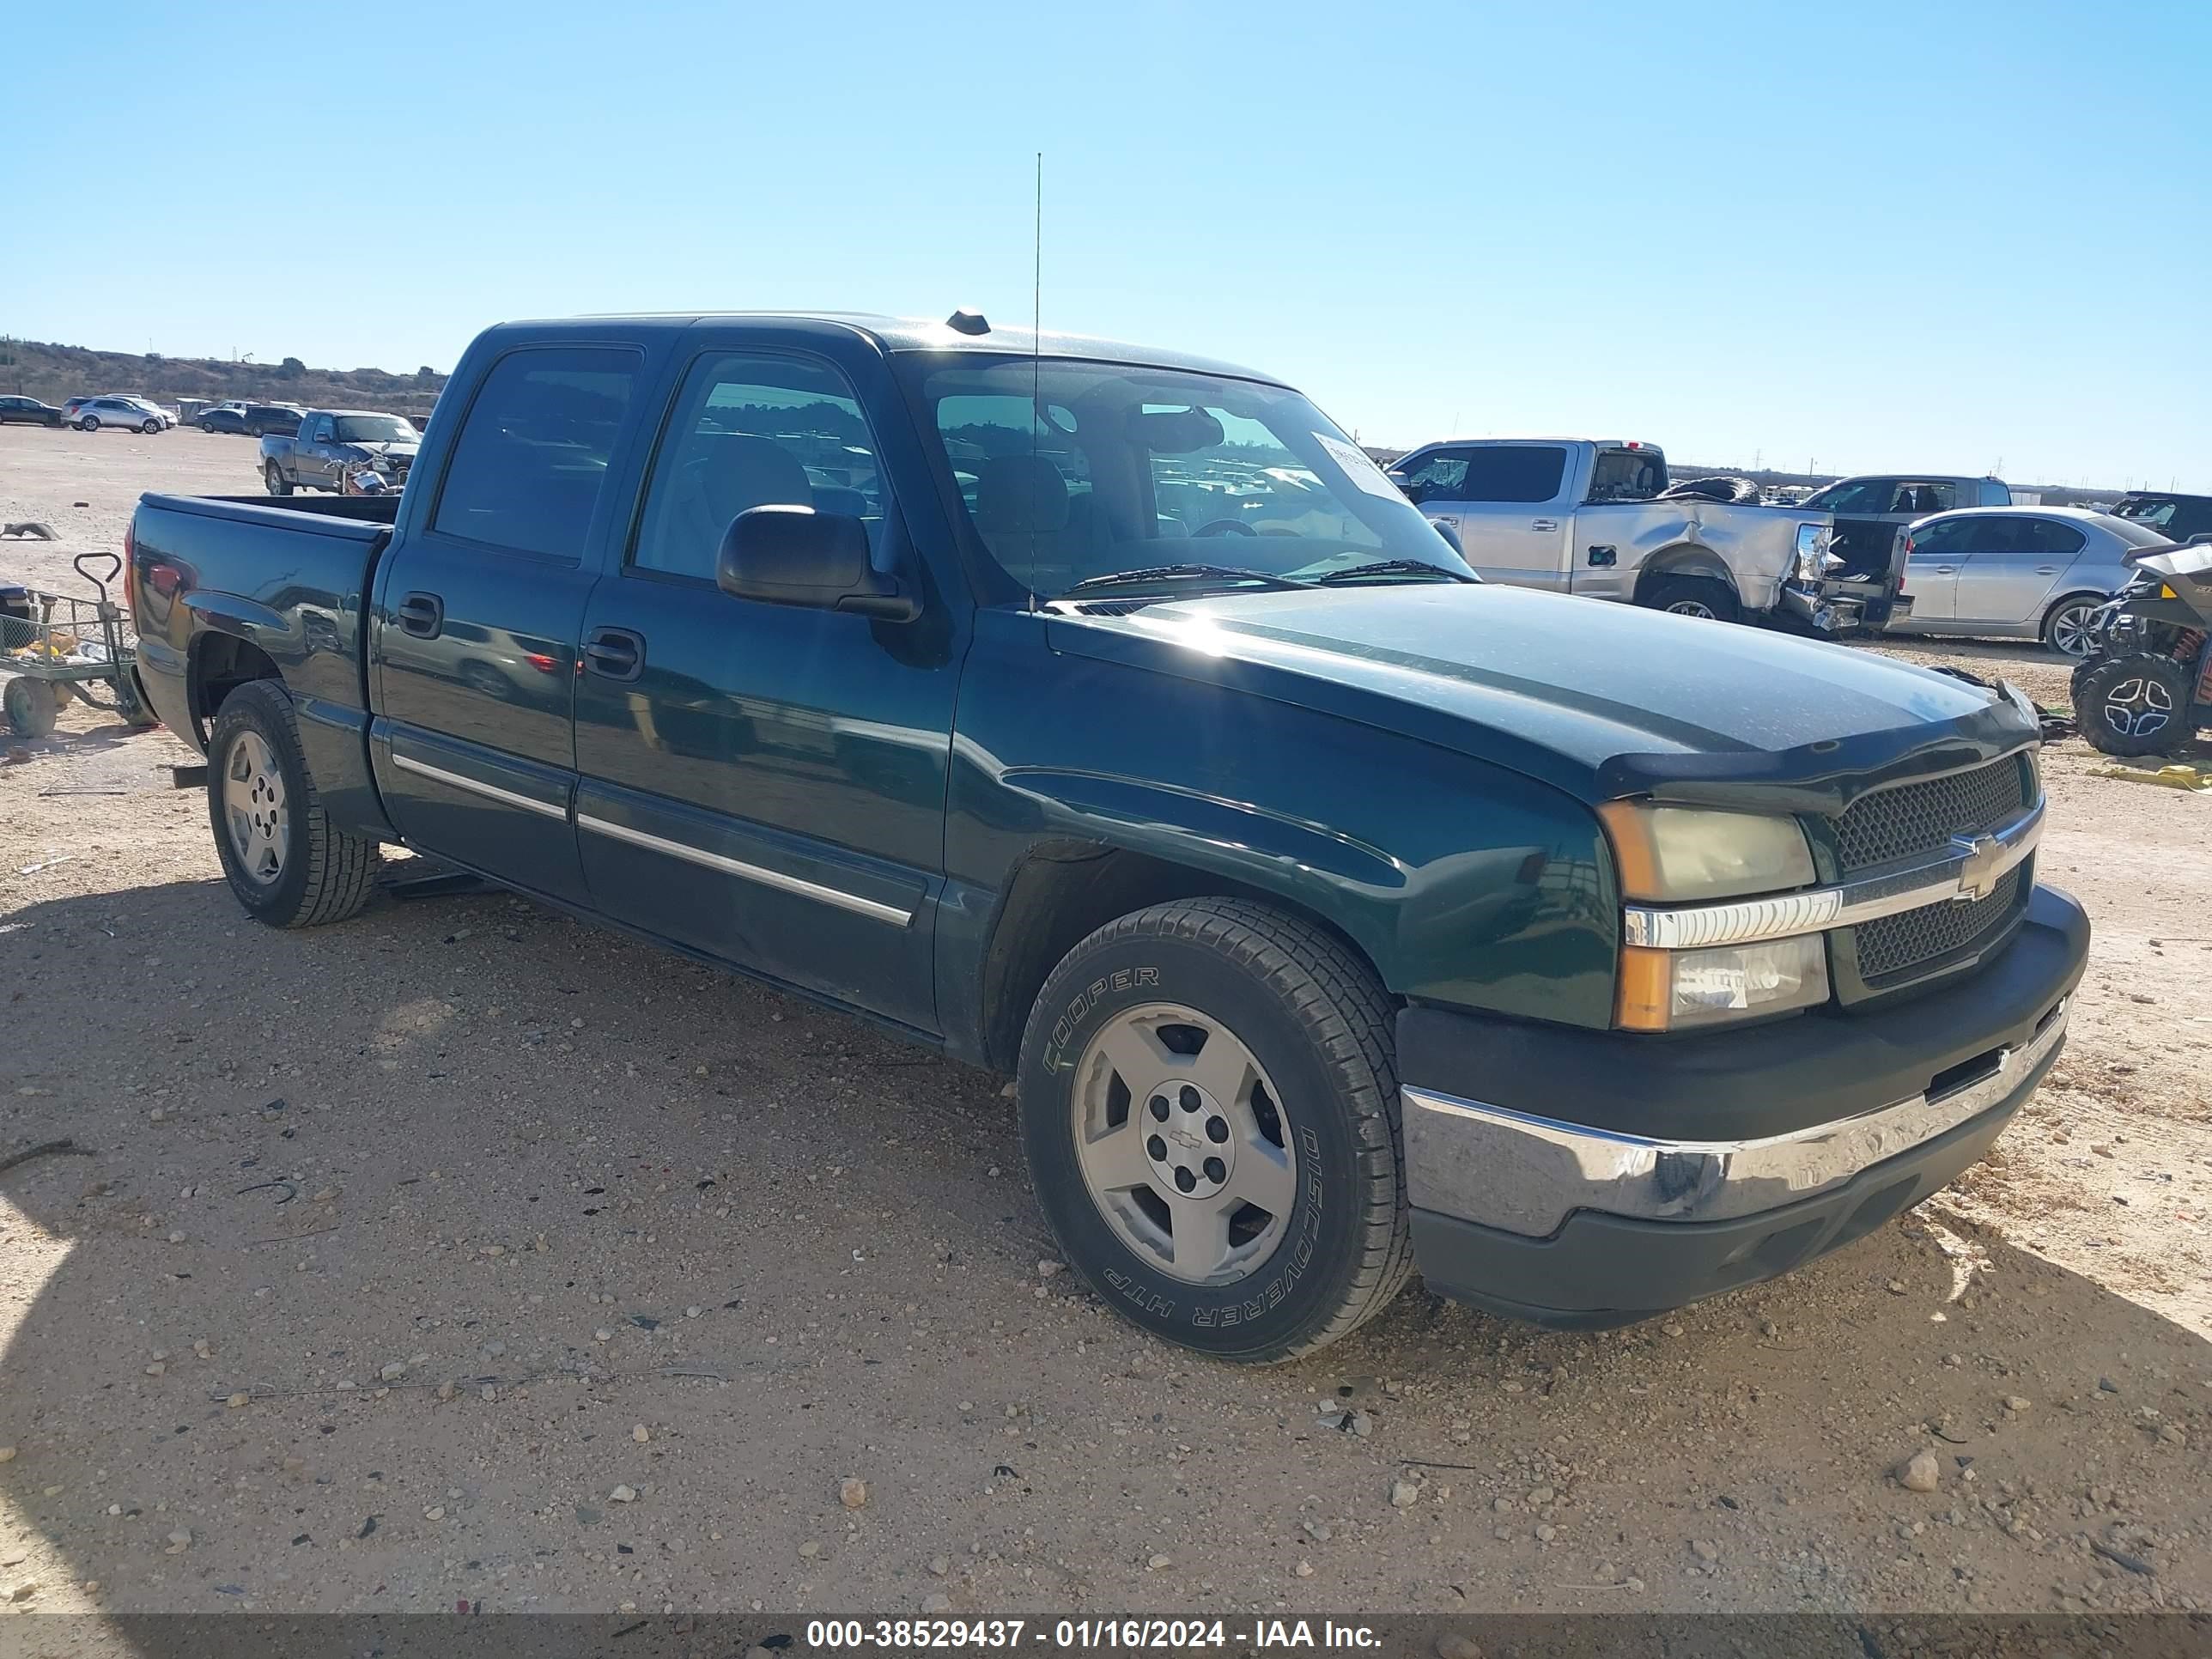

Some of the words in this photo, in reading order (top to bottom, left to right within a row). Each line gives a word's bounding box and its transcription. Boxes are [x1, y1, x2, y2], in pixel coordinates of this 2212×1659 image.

[1042, 967, 1159, 1075] COOPER
[1192, 1125, 1323, 1328] DISCOVERER
[1103, 1267, 1176, 1318] HTP
